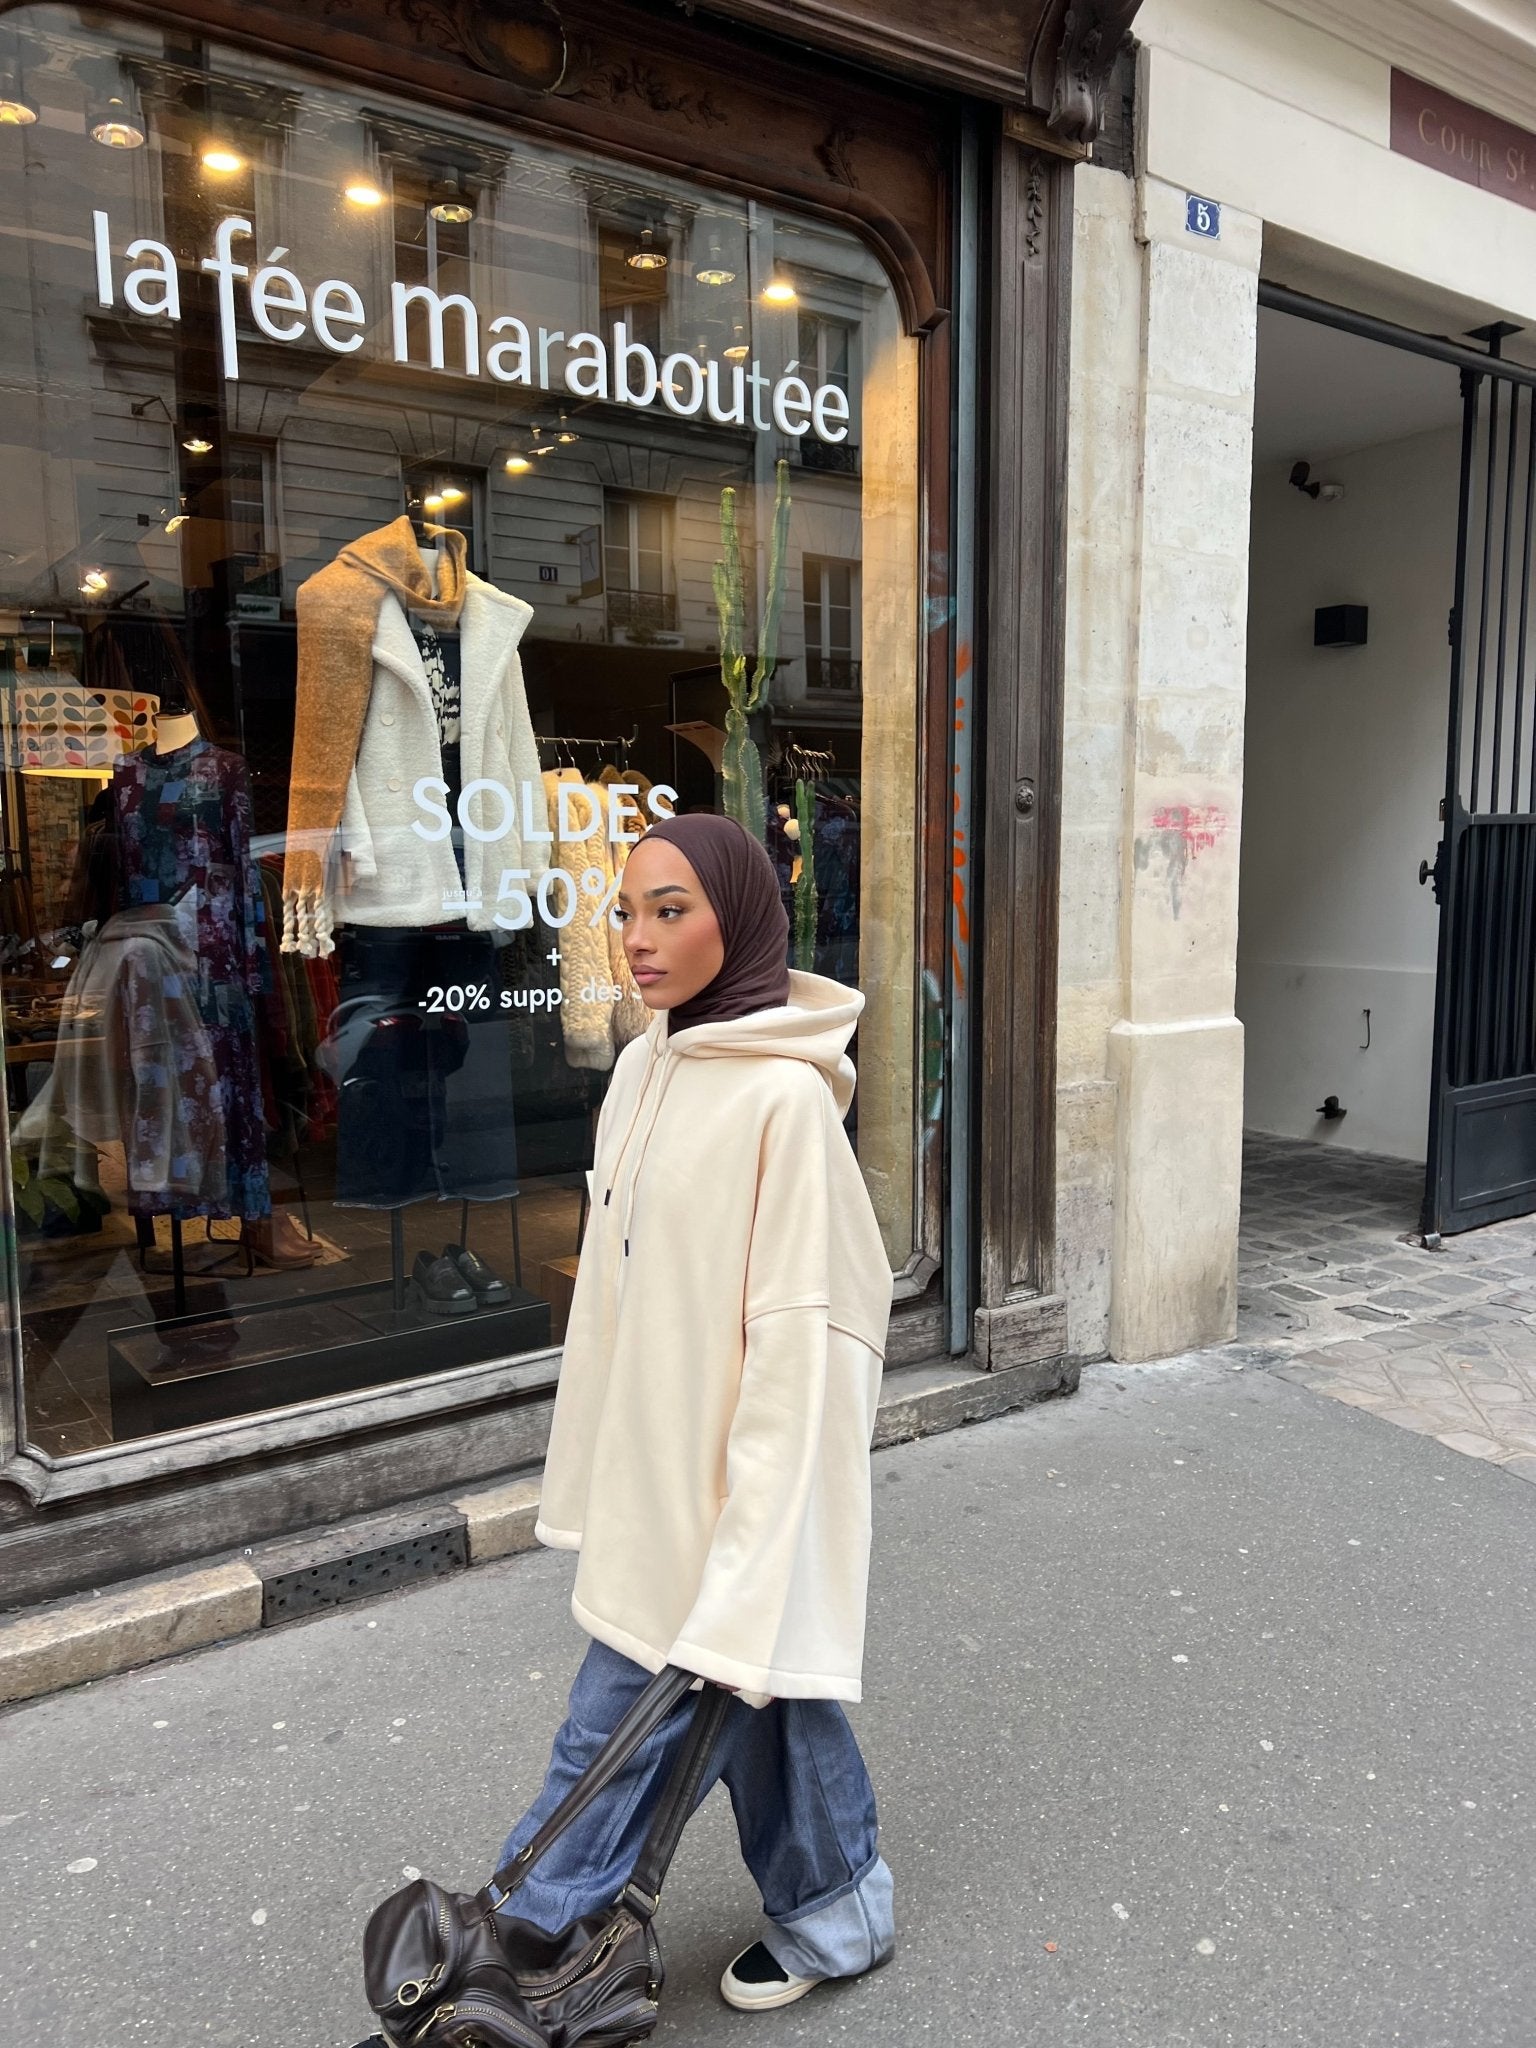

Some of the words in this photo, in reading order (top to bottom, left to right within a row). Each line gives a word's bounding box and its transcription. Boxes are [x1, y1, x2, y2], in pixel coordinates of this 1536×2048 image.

[1418, 108, 1494, 173] COUR
[1196, 203, 1211, 231] 5
[92, 209, 182, 322] la
[201, 215, 366, 381] fée
[390, 280, 850, 444] maraboutée
[418, 984, 491, 1013] -20%
[499, 985, 570, 1014] supp.
[580, 976, 623, 1002] dès
